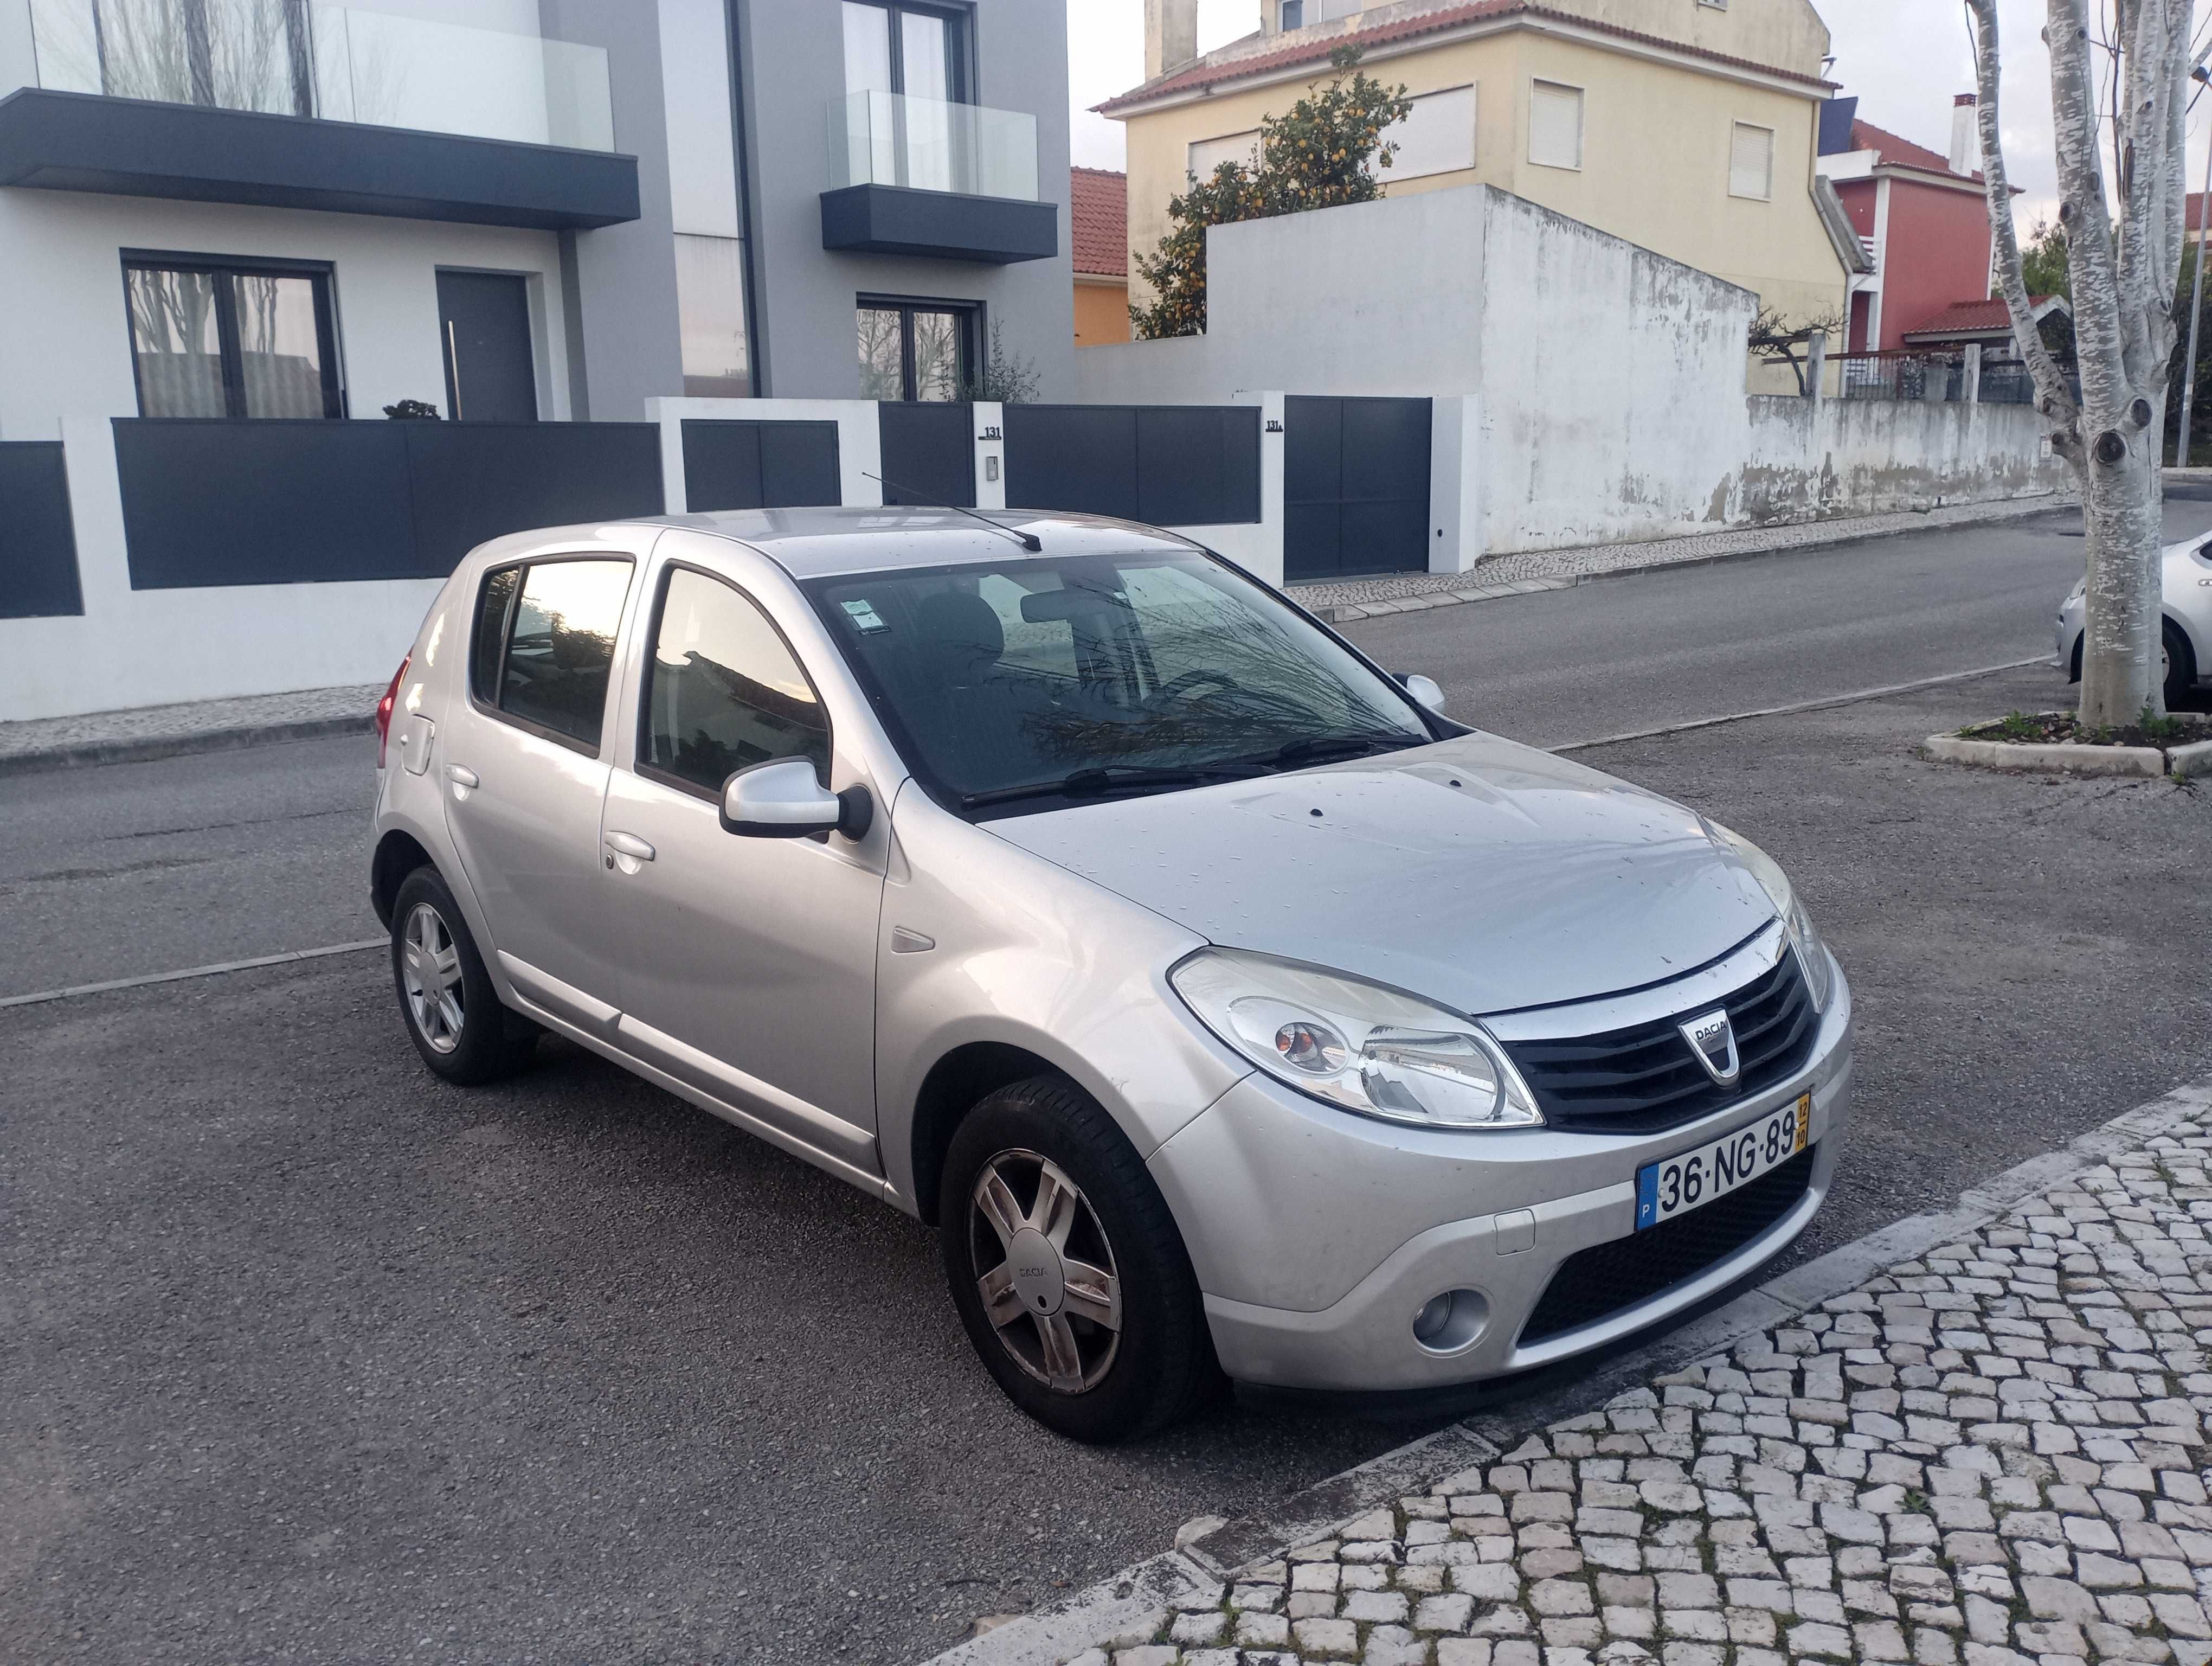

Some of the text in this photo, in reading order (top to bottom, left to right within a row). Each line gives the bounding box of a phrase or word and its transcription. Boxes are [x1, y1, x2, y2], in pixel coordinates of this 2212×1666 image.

[985, 426, 1000, 438] 131
[1695, 1021, 1727, 1041] DACIA
[1799, 1101, 1807, 1119] 12
[1797, 1129, 1805, 1146] 10
[1643, 1203, 1650, 1218] P
[1019, 1268, 1049, 1277] DACIA
